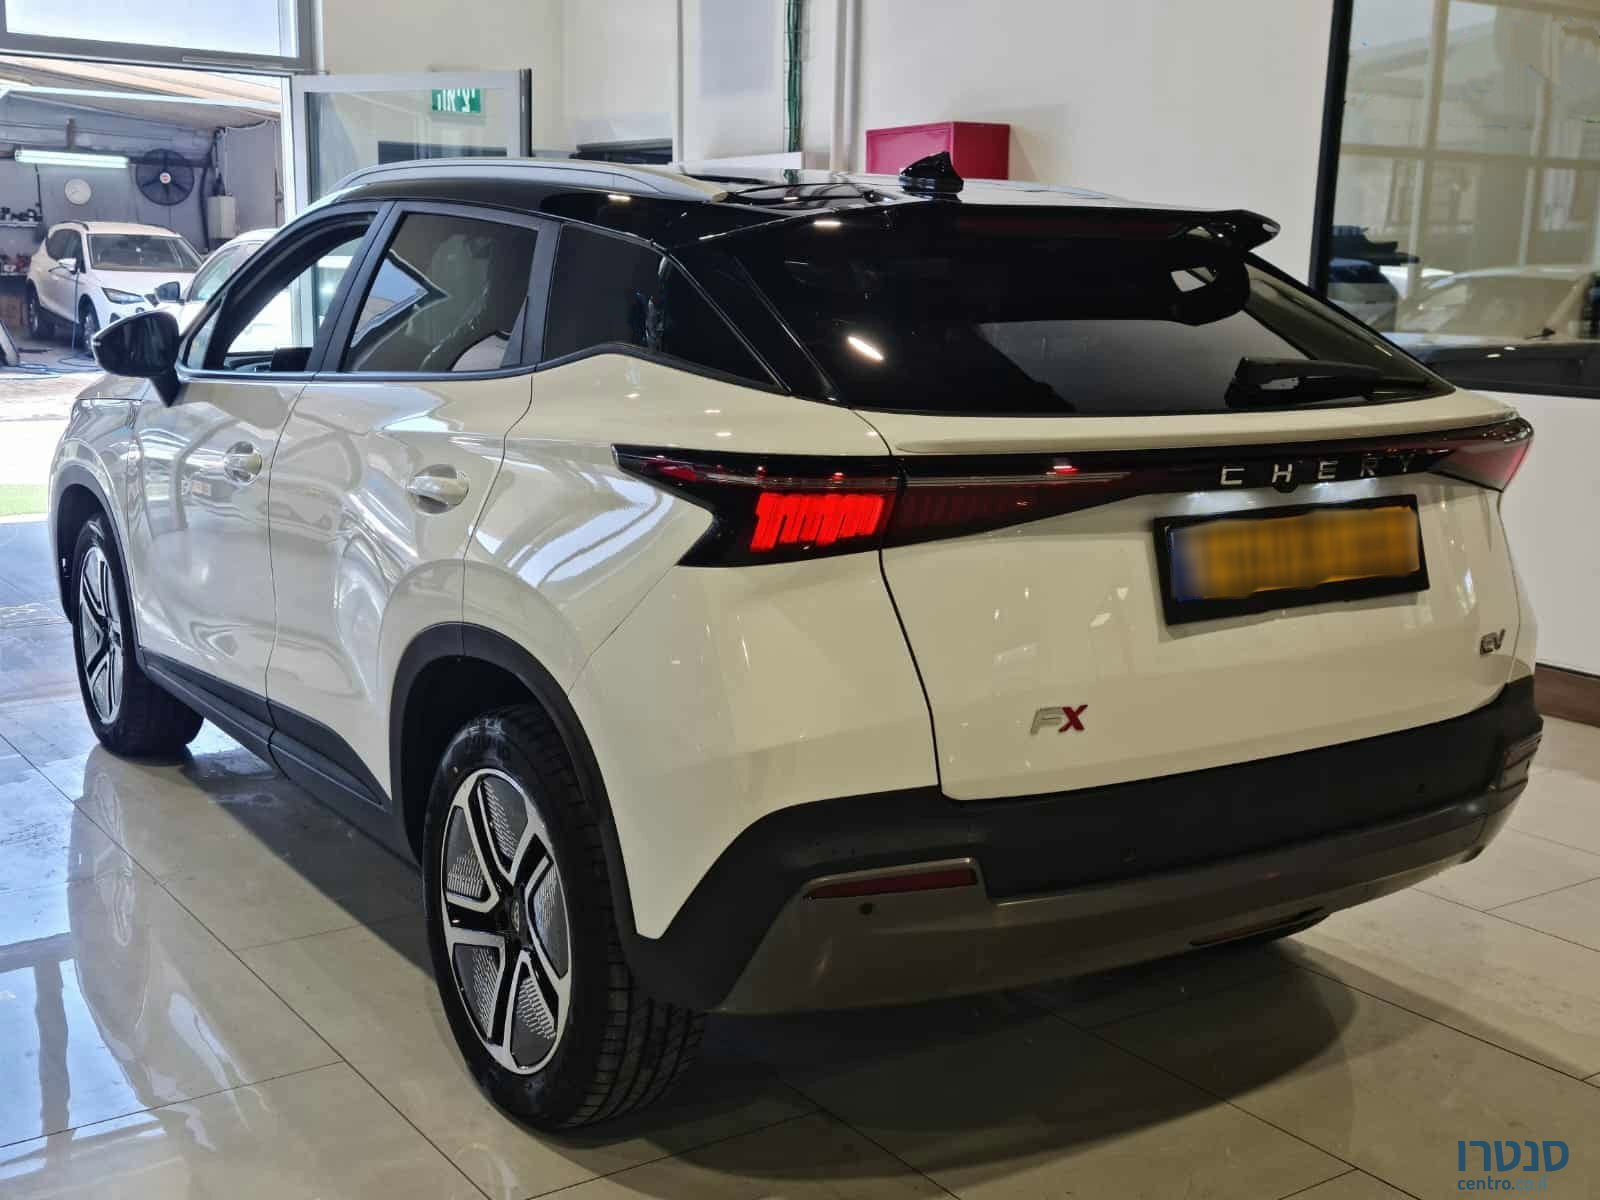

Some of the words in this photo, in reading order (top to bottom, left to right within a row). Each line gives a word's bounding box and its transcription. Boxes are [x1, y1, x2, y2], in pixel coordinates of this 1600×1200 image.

[1220, 452, 1416, 486] CHERY
[1480, 629, 1506, 656] EV
[1030, 704, 1088, 735] FX
